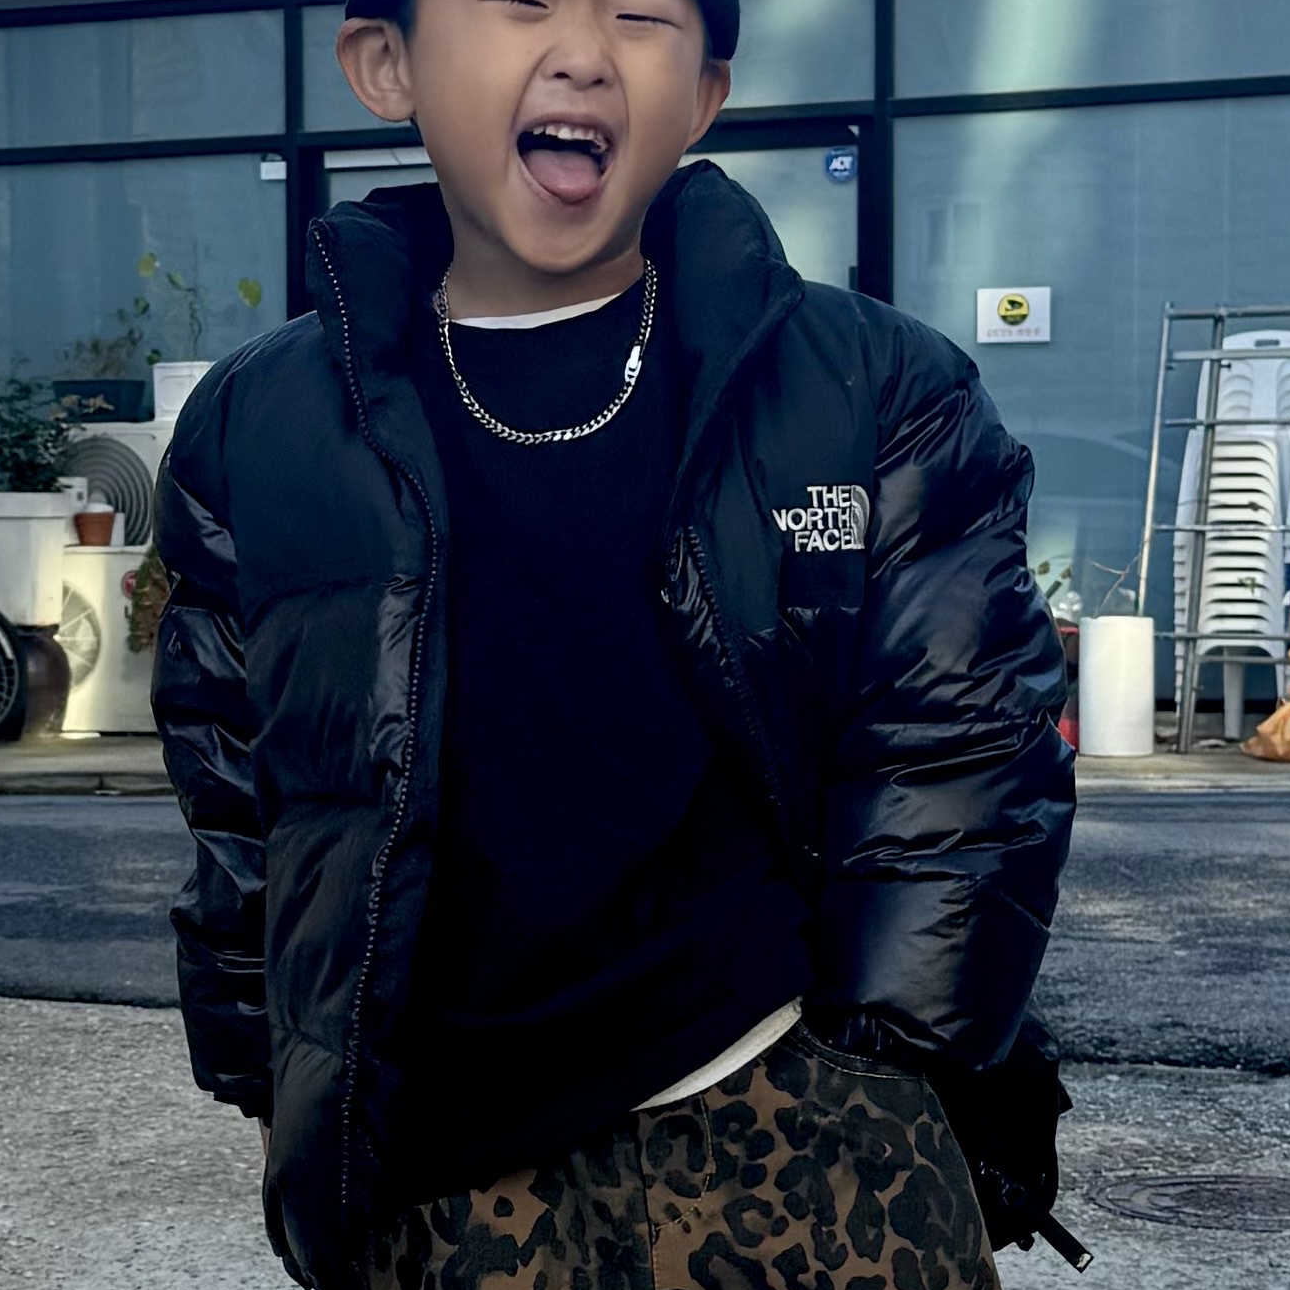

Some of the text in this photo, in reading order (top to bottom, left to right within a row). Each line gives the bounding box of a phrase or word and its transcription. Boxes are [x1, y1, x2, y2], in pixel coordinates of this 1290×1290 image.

[806, 485, 851, 508] THE
[772, 508, 851, 531] NORTH
[795, 529, 853, 552] FACE
